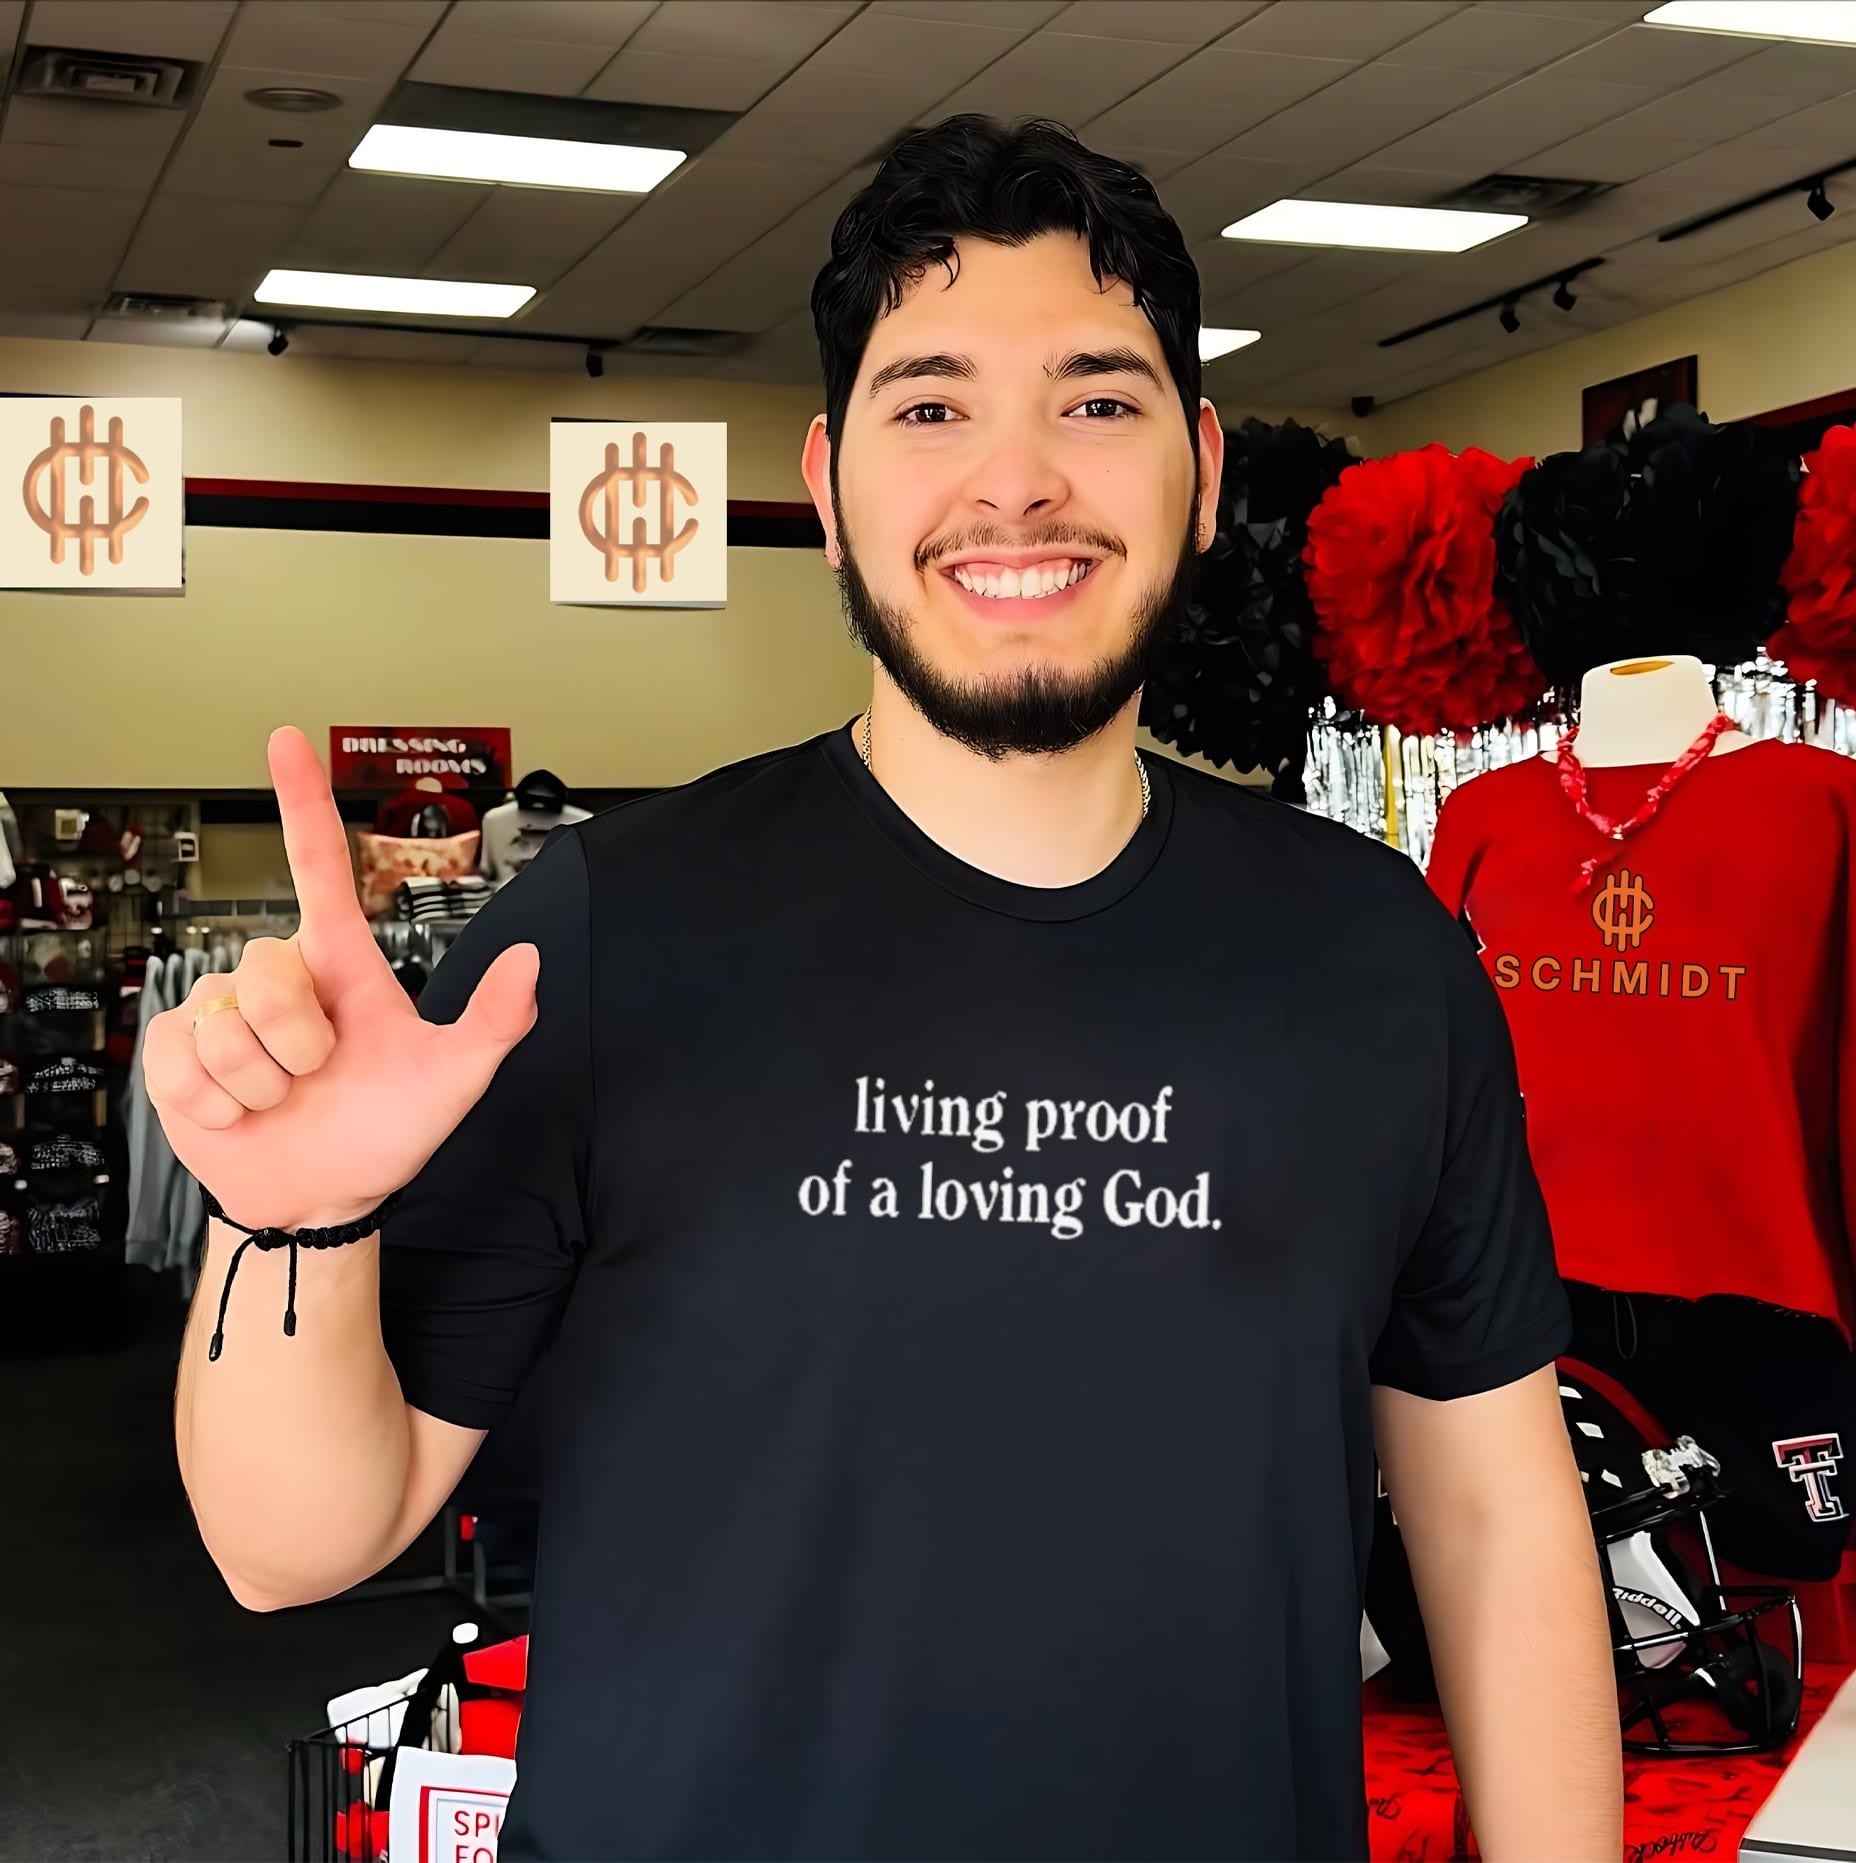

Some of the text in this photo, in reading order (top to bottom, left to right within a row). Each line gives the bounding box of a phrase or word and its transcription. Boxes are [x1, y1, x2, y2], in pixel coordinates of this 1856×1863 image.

[396, 758, 487, 775] ROOMS
[1494, 954, 1746, 1000] SCHMIDT
[854, 1076, 1173, 1153] living proof
[798, 1159, 1222, 1240] of a loving God.
